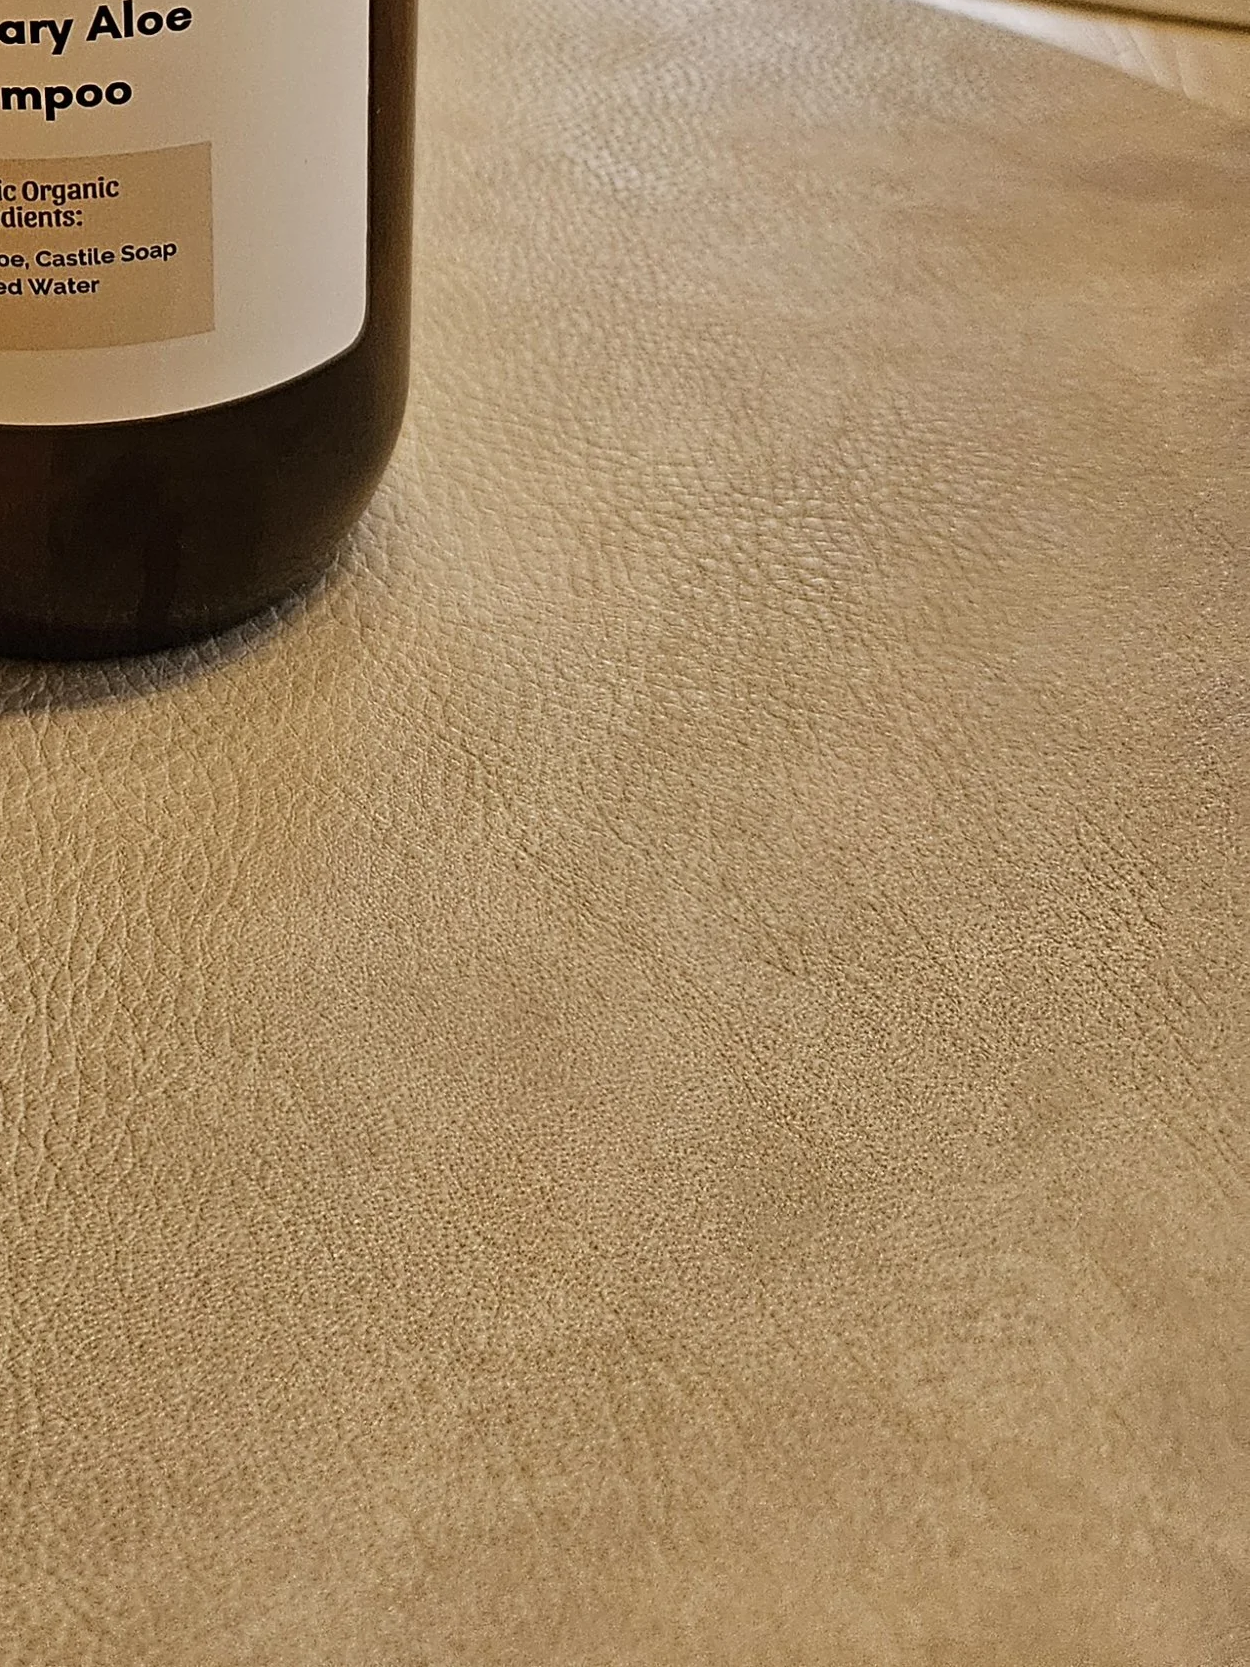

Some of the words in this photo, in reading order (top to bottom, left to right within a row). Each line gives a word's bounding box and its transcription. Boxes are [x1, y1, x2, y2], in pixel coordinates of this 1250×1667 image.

[86, 0, 192, 41] Aloe
[21, 176, 120, 206] Organic
[35, 247, 115, 268] Castile
[121, 242, 178, 262] Soap
[28, 277, 100, 296] Water
